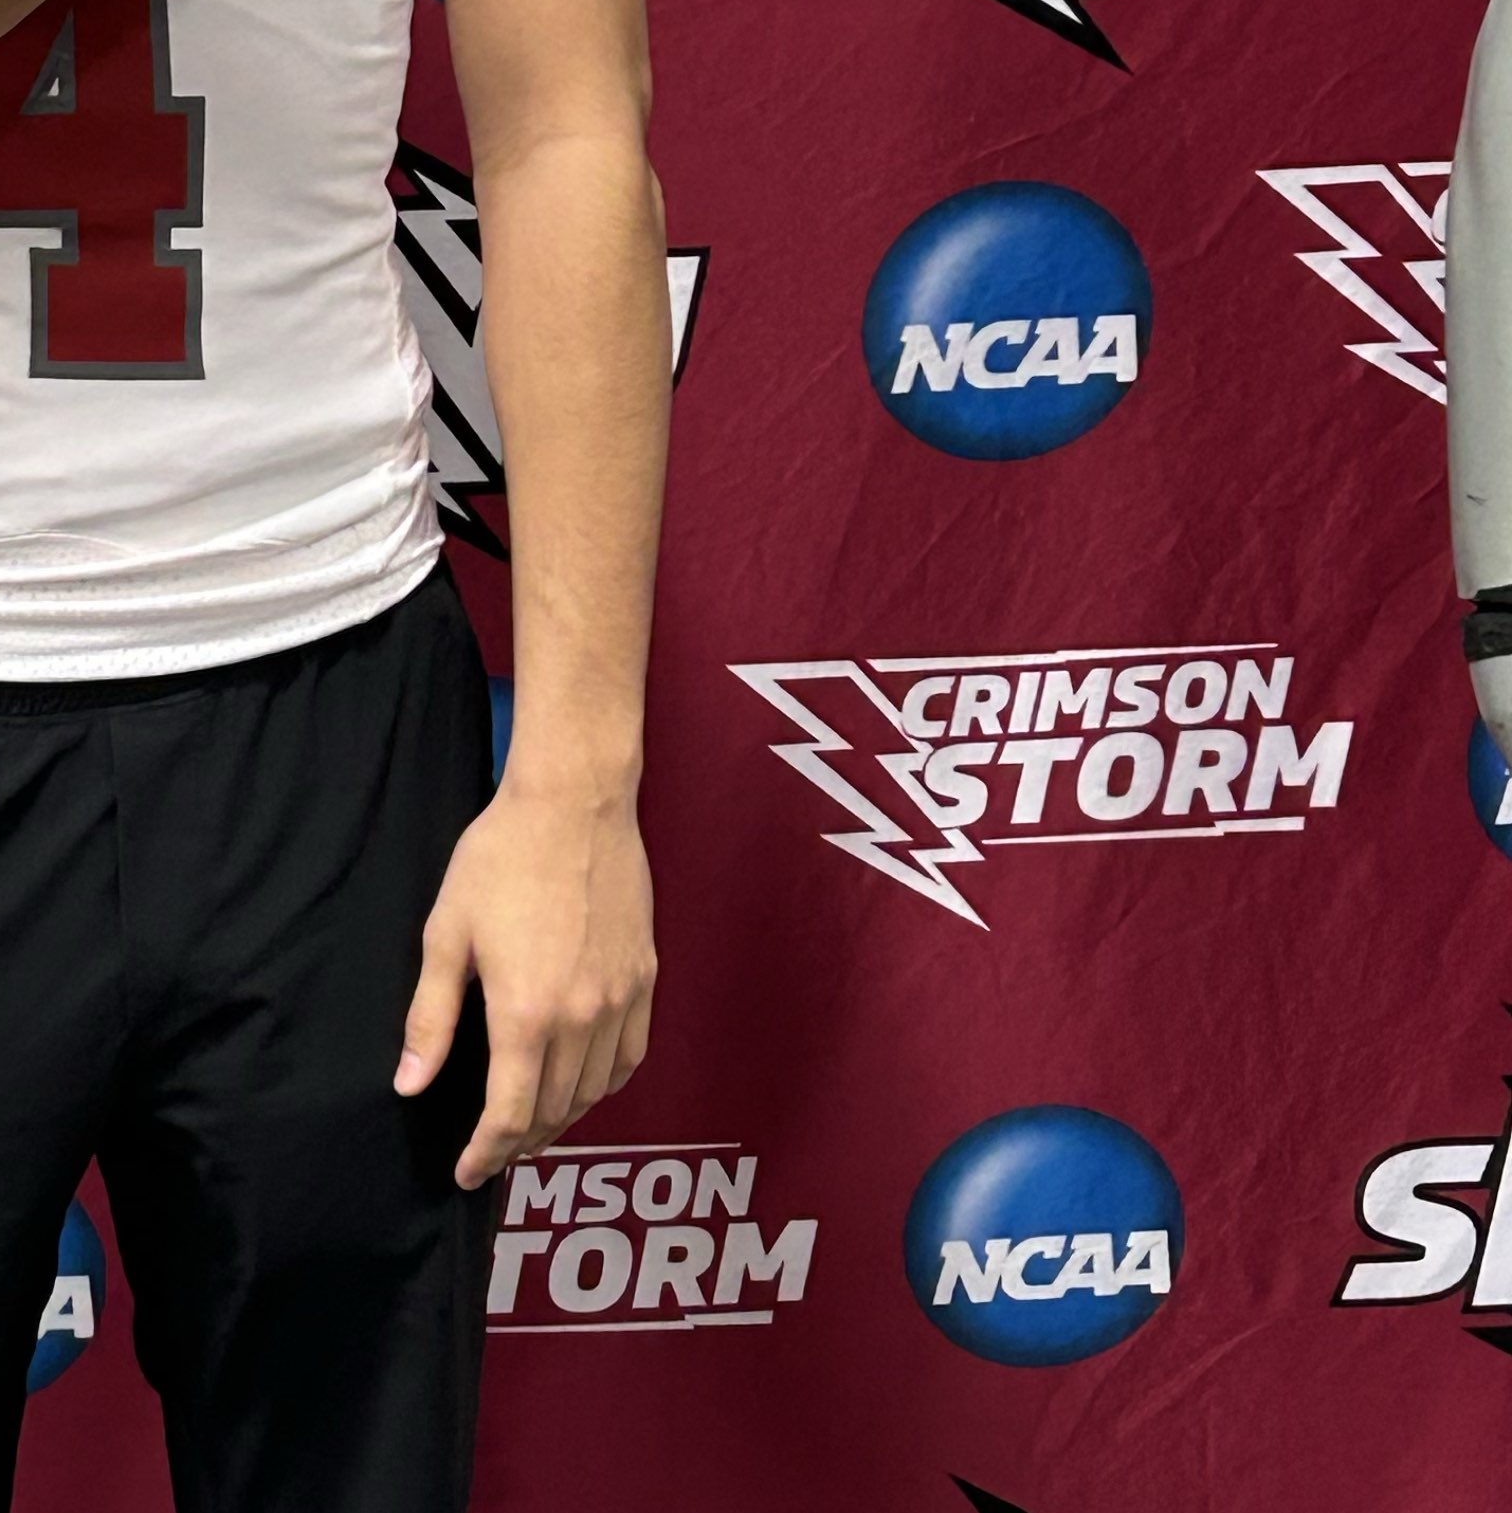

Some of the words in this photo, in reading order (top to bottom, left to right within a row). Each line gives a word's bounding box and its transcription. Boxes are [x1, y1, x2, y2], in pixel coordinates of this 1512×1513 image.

[890, 314, 1138, 394] NCAA
[900, 657, 1294, 740] CRIMSON
[924, 721, 1354, 829] STORM
[502, 1155, 758, 1226] MSON
[486, 1219, 819, 1314] TORM
[932, 1229, 1171, 1308] NCAA
